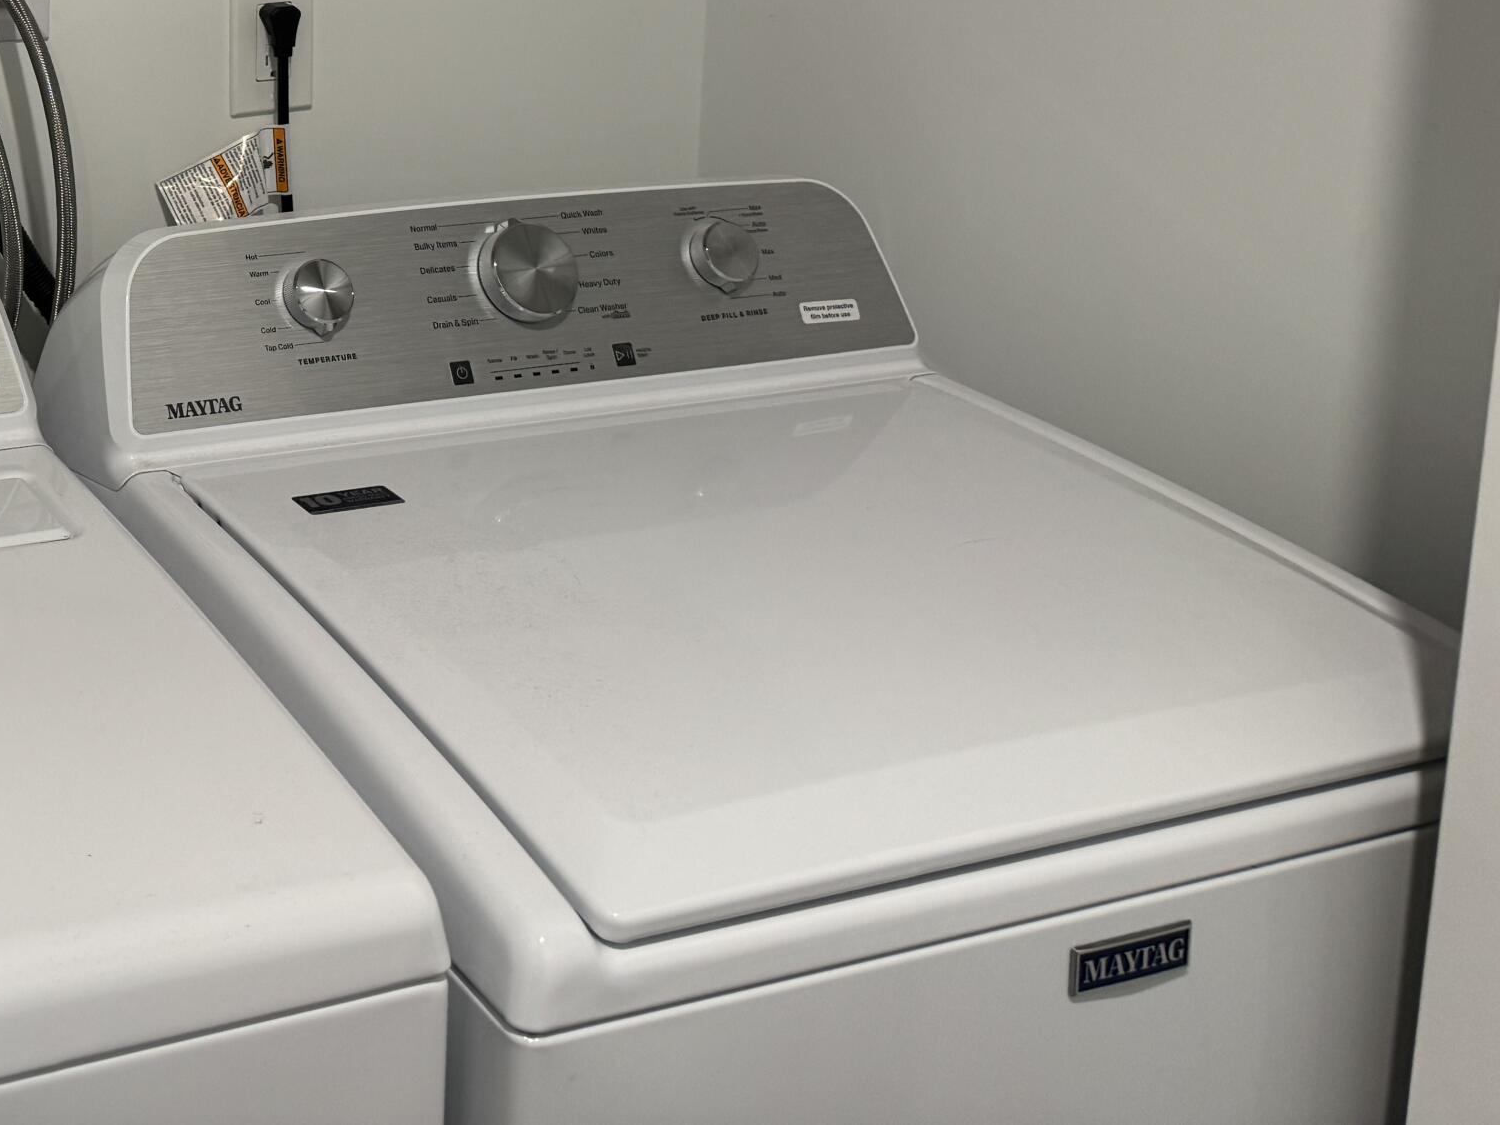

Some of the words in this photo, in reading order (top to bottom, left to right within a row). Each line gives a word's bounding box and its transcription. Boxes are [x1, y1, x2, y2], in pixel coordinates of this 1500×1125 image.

[277, 146, 286, 183] WARNING
[560, 210, 582, 220] Quick
[582, 209, 603, 218] Wash
[410, 224, 438, 234] Normal
[581, 226, 607, 235] Whites
[414, 242, 435, 252] Bulky
[436, 240, 458, 250] Items
[589, 250, 614, 259] Colors
[419, 265, 456, 275] Delicates
[578, 278, 602, 288] Heavy
[602, 277, 621, 288] Duty
[426, 294, 458, 304] Casuals
[577, 305, 599, 314] Clean
[599, 302, 628, 312] Washer
[701, 313, 720, 322] DEEP
[721, 311, 738, 320] FILL
[746, 308, 768, 317] RINSE
[433, 319, 454, 330] Drain
[454, 319, 461, 328] &
[461, 318, 479, 328] Spin
[265, 344, 277, 352] Tap
[277, 342, 294, 350] Cold
[298, 353, 357, 365] TEMPERATURE
[165, 395, 243, 420] MAYTAG
[300, 494, 342, 508] 10
[1083, 937, 1185, 984] MAYTAG
